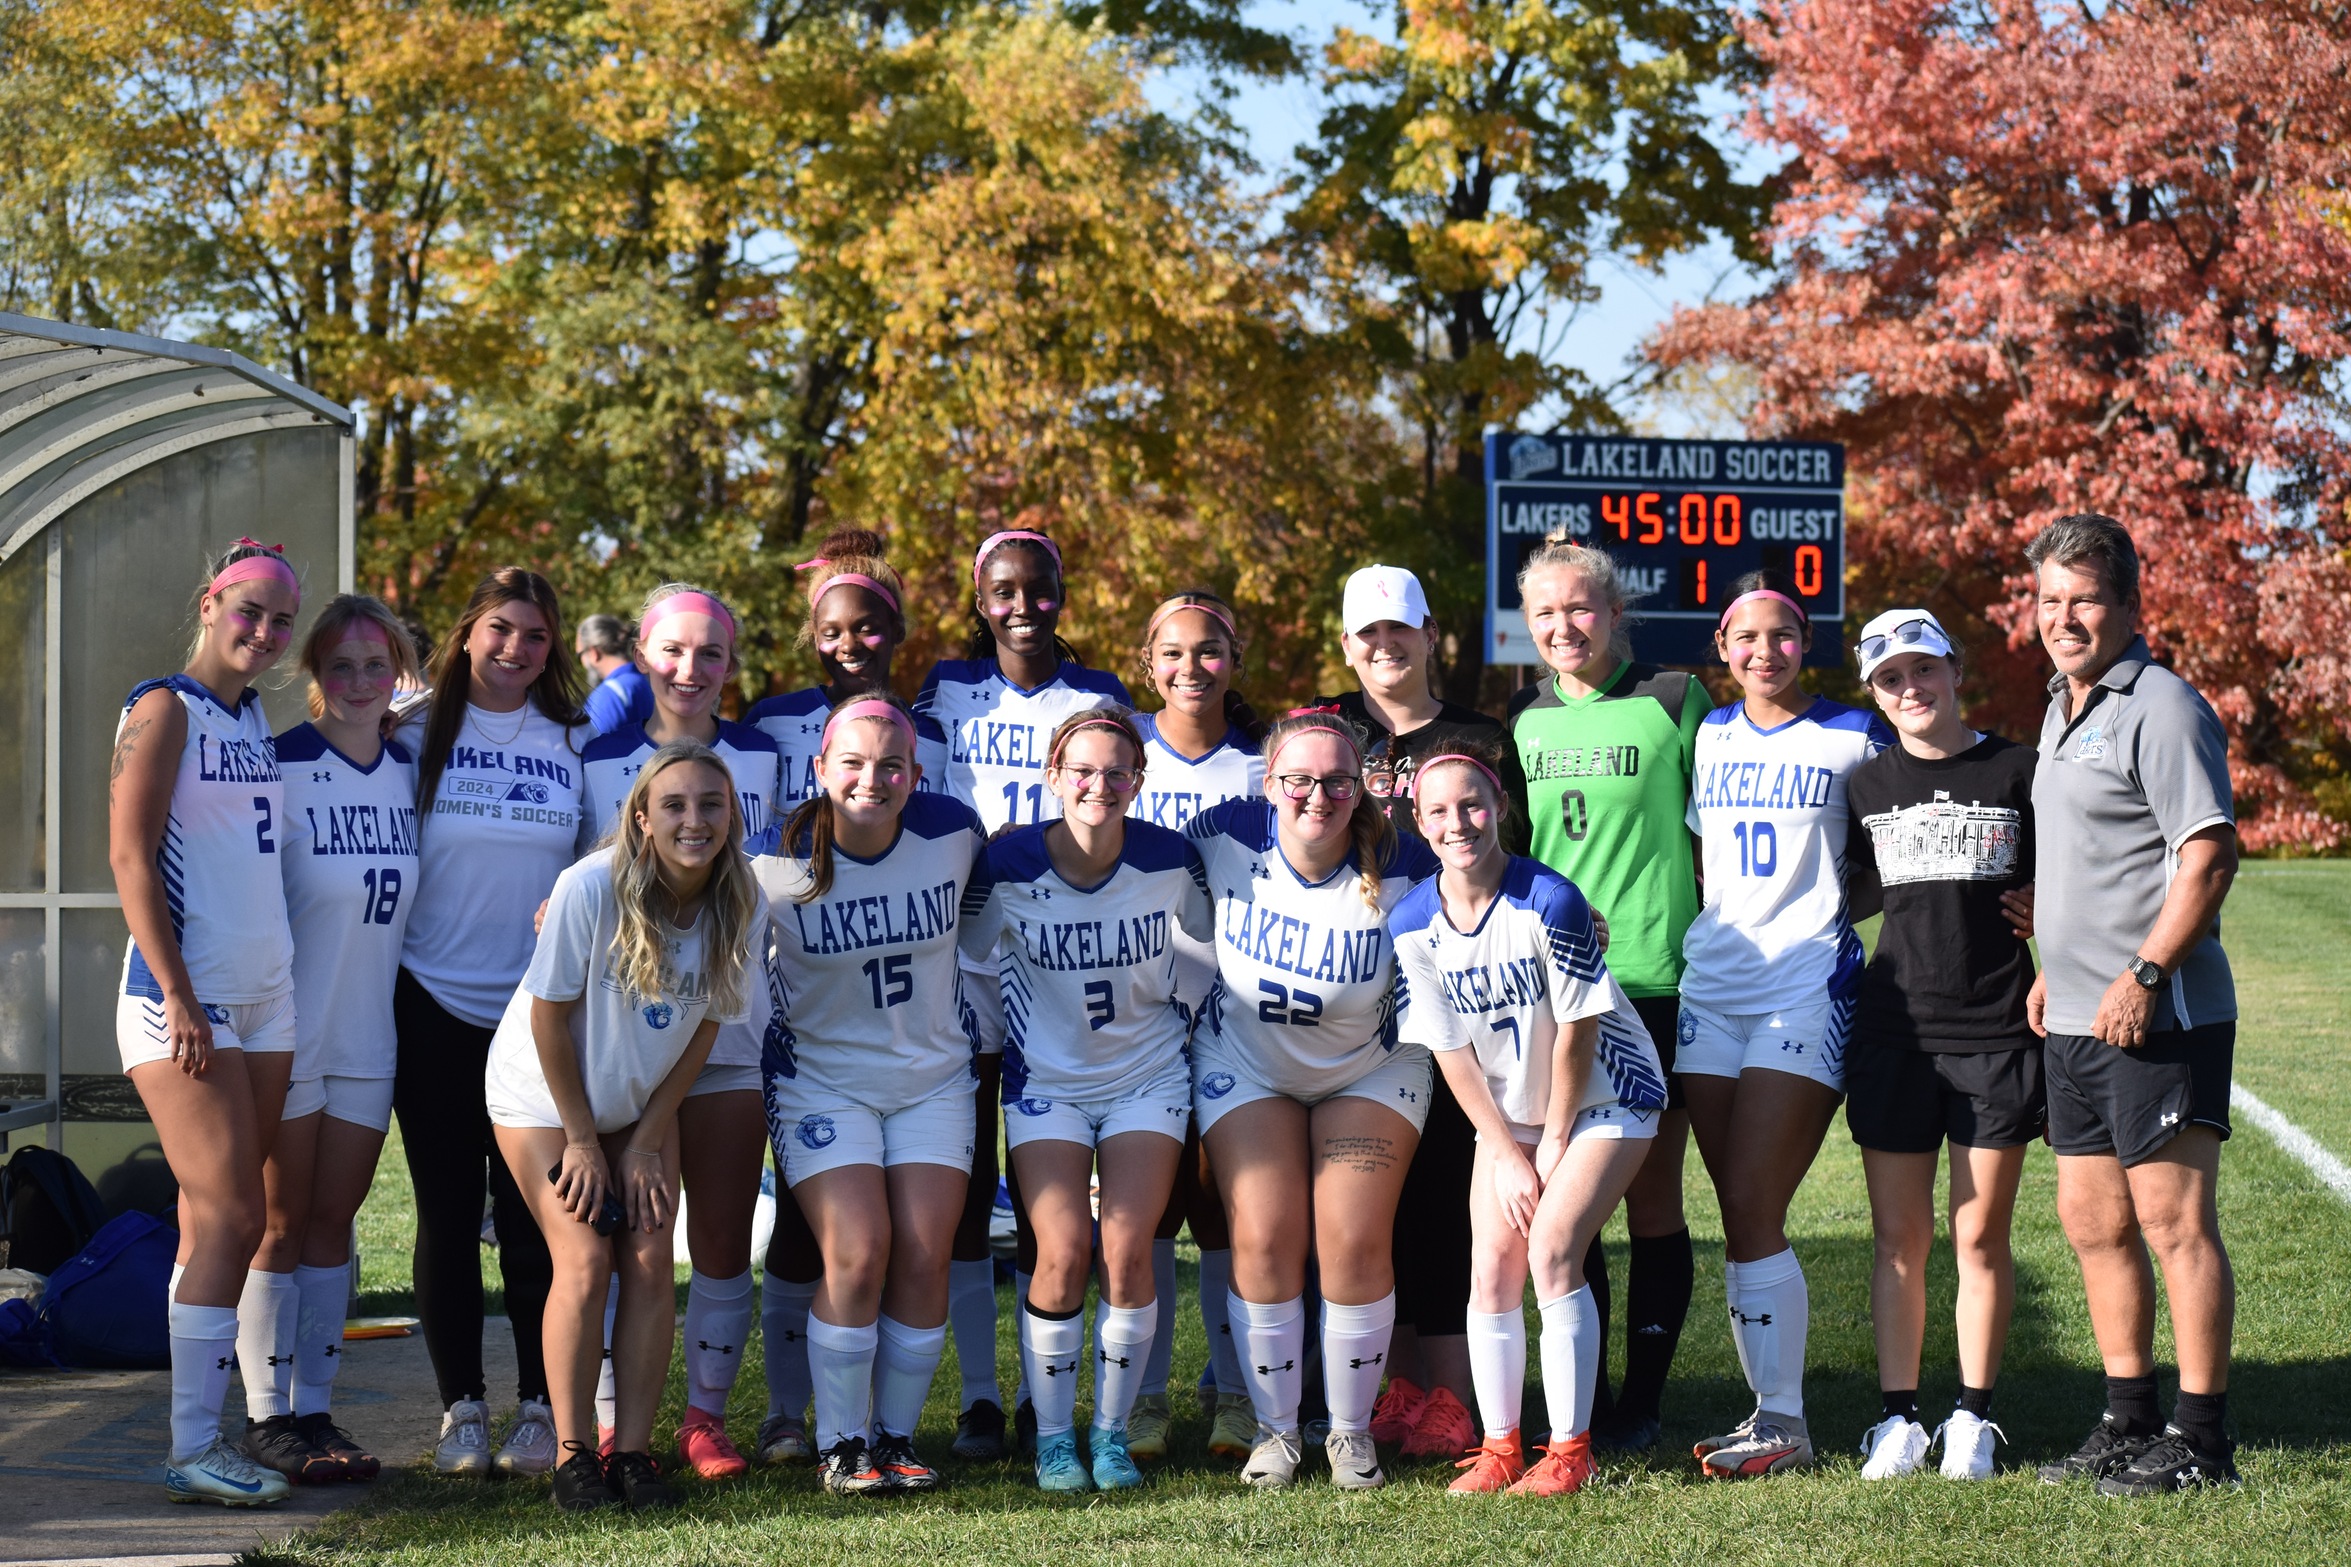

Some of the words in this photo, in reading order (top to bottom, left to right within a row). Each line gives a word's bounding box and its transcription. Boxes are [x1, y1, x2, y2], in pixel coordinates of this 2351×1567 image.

[1562, 442, 1716, 479] LAKELAND
[1726, 447, 1832, 482] SOCCER
[1502, 502, 1591, 536] LAKERS
[1601, 492, 1742, 546] 45:00
[1750, 507, 1836, 541] GUEST
[1696, 559, 1707, 605] 1
[1795, 545, 1823, 597] 0
[199, 734, 282, 782] LAKELAN
[446, 746, 572, 790] KELAND
[952, 719, 1047, 769] LAKEL
[1526, 745, 1639, 783] LAKELAND
[457, 780, 494, 796] 2024
[1002, 781, 1043, 825] 11
[253, 796, 276, 854] 2
[306, 805, 418, 856] LAKELAND
[435, 800, 502, 819] OMEN'S
[511, 806, 573, 828] SOCCER
[1561, 789, 1588, 841] 0
[1733, 821, 1777, 877] 10
[363, 868, 402, 925] 18
[793, 879, 956, 954] LAKELAND
[1019, 910, 1167, 971] LAKELAND
[1224, 888, 1382, 984] LAKELAND
[862, 953, 913, 1009] 15
[1084, 980, 1115, 1031] 3
[1258, 977, 1323, 1027] 22
[1438, 956, 1545, 1014] AKELAND
[1490, 1016, 1521, 1062] 7
